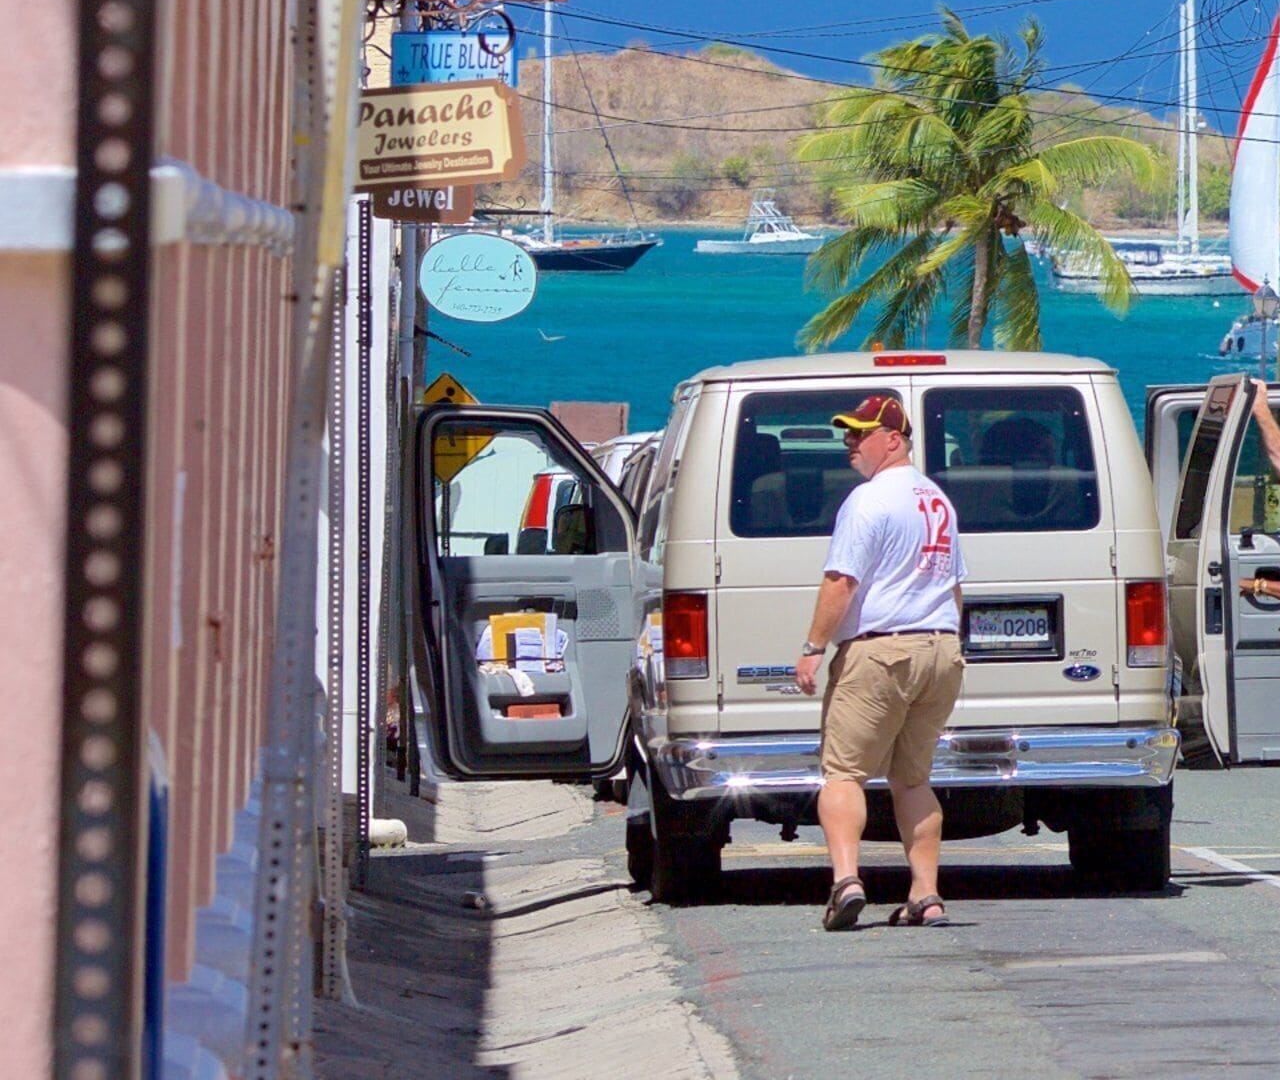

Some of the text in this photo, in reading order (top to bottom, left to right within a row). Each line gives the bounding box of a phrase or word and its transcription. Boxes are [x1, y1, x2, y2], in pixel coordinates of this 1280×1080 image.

[410, 43, 501, 70] TRUE BLUE
[358, 94, 493, 128] Panache
[374, 129, 473, 155] Jewelers
[443, 155, 489, 168] Destination
[918, 498, 951, 546] 12
[1003, 618, 1046, 637] 0208
